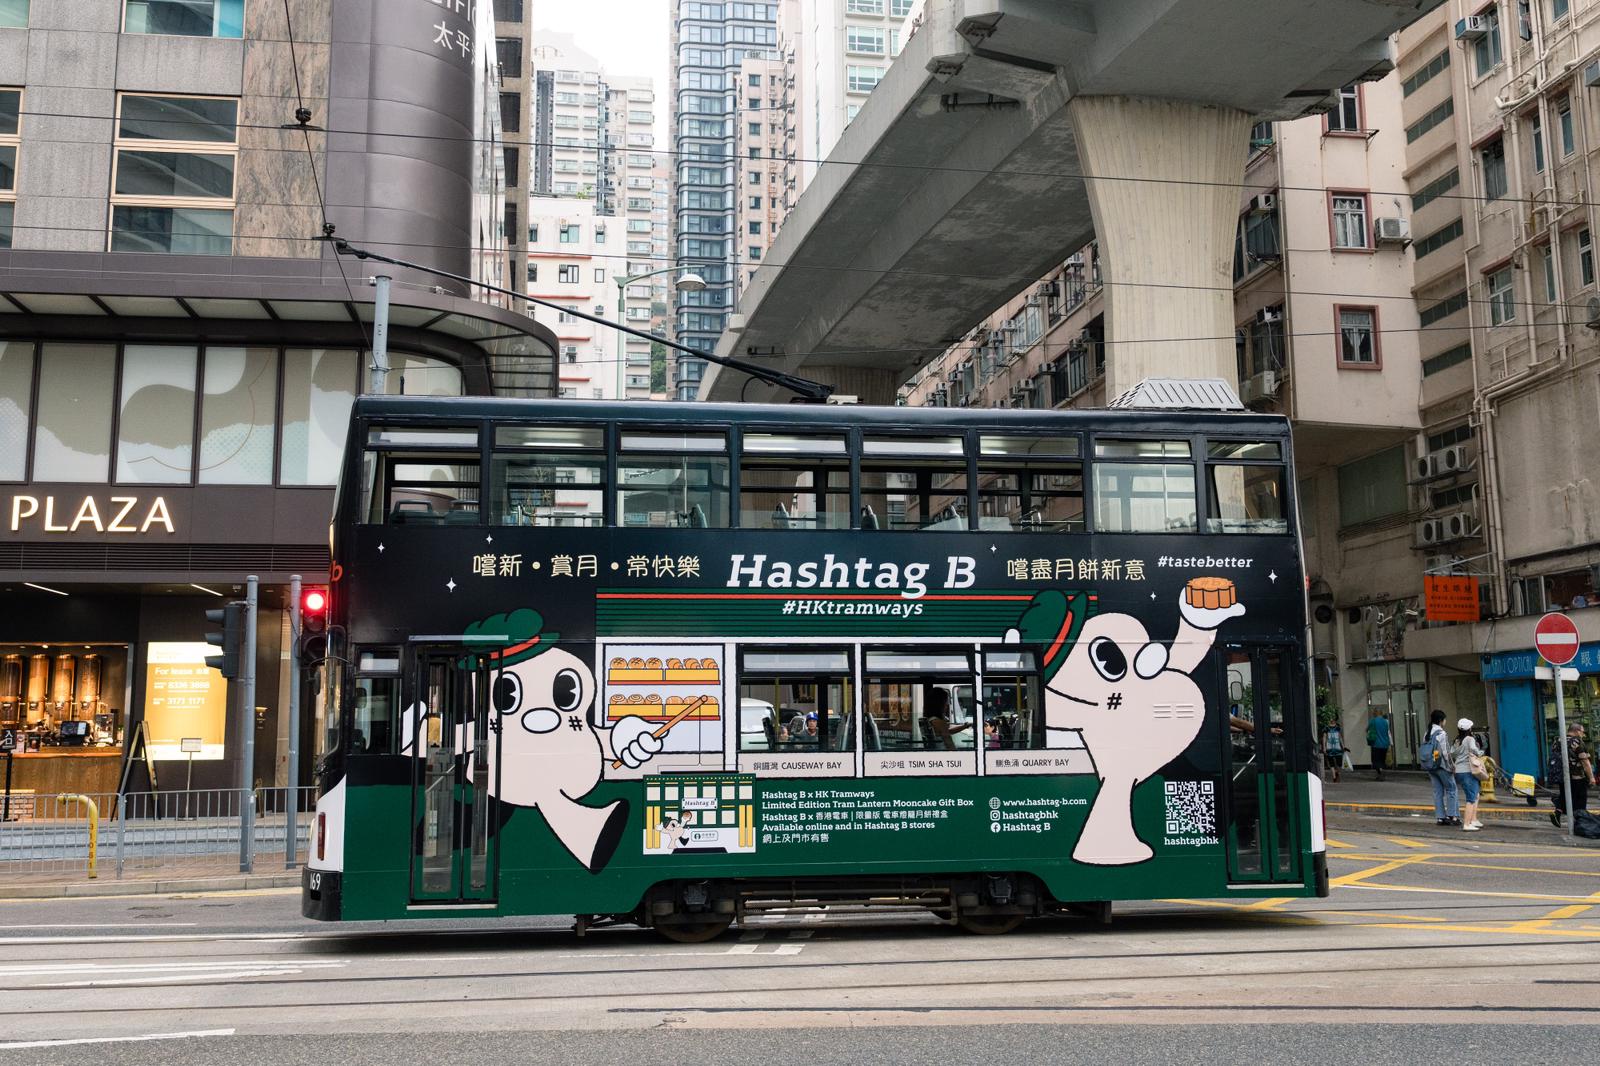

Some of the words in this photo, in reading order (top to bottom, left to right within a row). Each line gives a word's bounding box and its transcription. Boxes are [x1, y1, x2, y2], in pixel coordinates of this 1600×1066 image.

[11, 495, 175, 533] PLAZA
[1158, 556, 1253, 568] #tastebetter
[1007, 558, 1146, 581] 嚐盡月餅新意
[726, 553, 930, 599] Hashtag
[943, 556, 976, 588] B
[782, 600, 923, 618] #HKtramways
[5, 730, 13, 745] 入口
[781, 762, 824, 770] CAUSEWAY
[1022, 759, 1052, 767] QUARRY
[762, 792, 798, 800] Hashtag
[830, 790, 874, 798] Tramways
[893, 799, 936, 807] Mooncake
[762, 814, 798, 822] Hashtag
[1002, 810, 1058, 821] hashtagbhk
[864, 822, 900, 830] Hashtag
[1002, 823, 1042, 832] Hashtag
[1044, 822, 1050, 830] B
[1164, 836, 1218, 846] hashtagbhk
